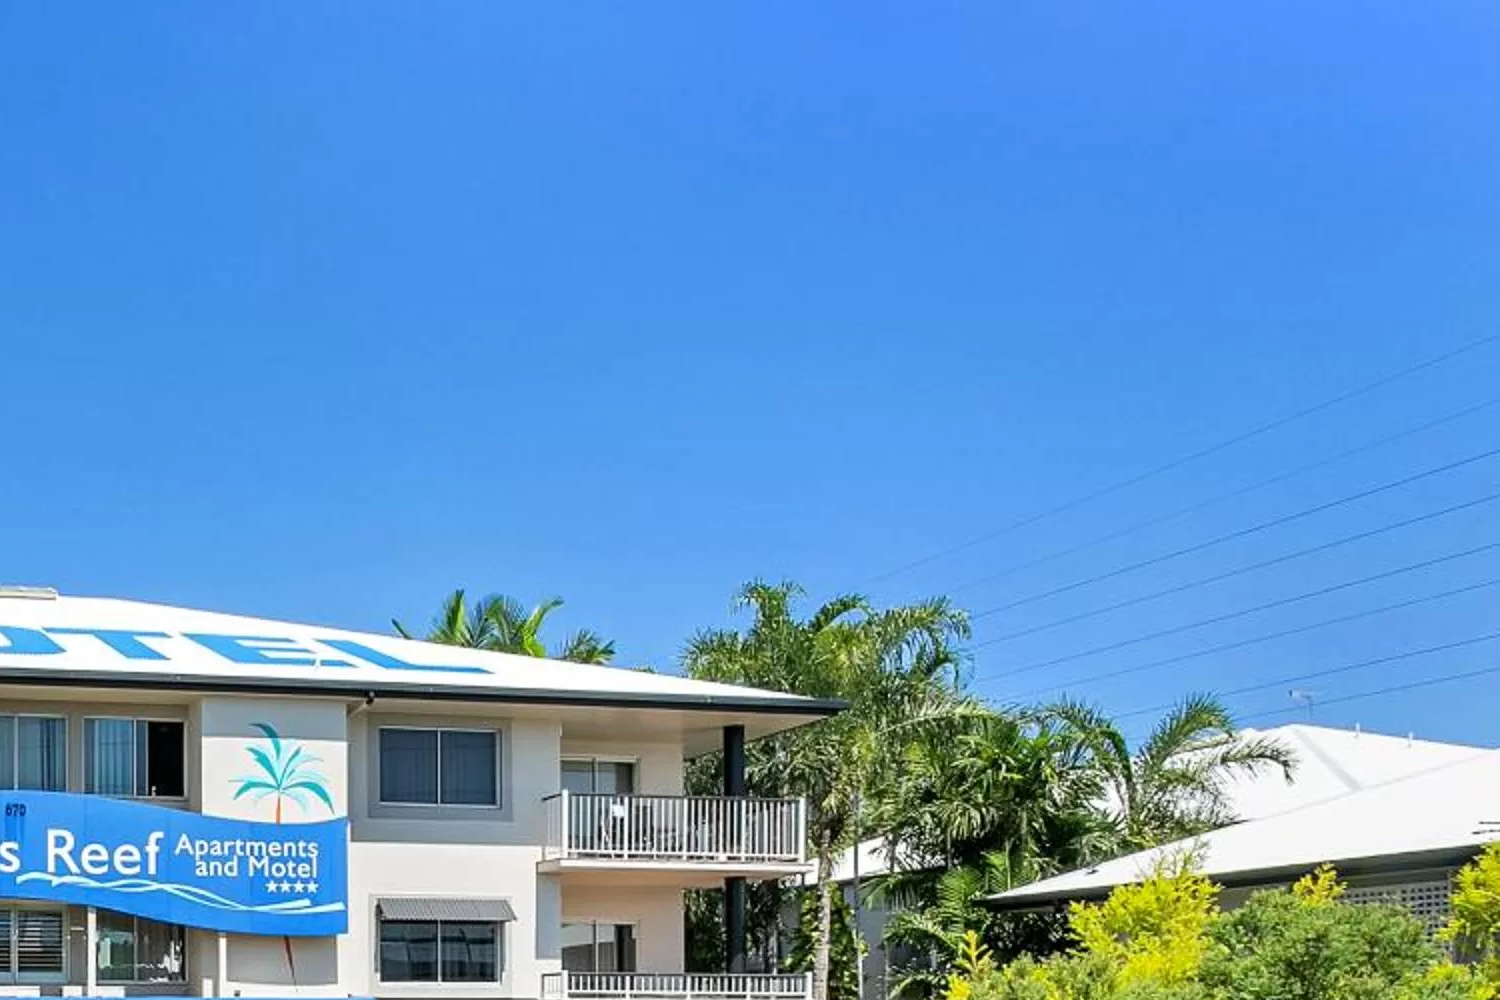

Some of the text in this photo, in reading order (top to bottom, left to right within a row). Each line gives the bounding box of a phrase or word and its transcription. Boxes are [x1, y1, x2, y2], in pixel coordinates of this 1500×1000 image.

[47, 828, 165, 876] Reef
[174, 833, 320, 858] Apartments
[195, 855, 318, 879] and Motel
